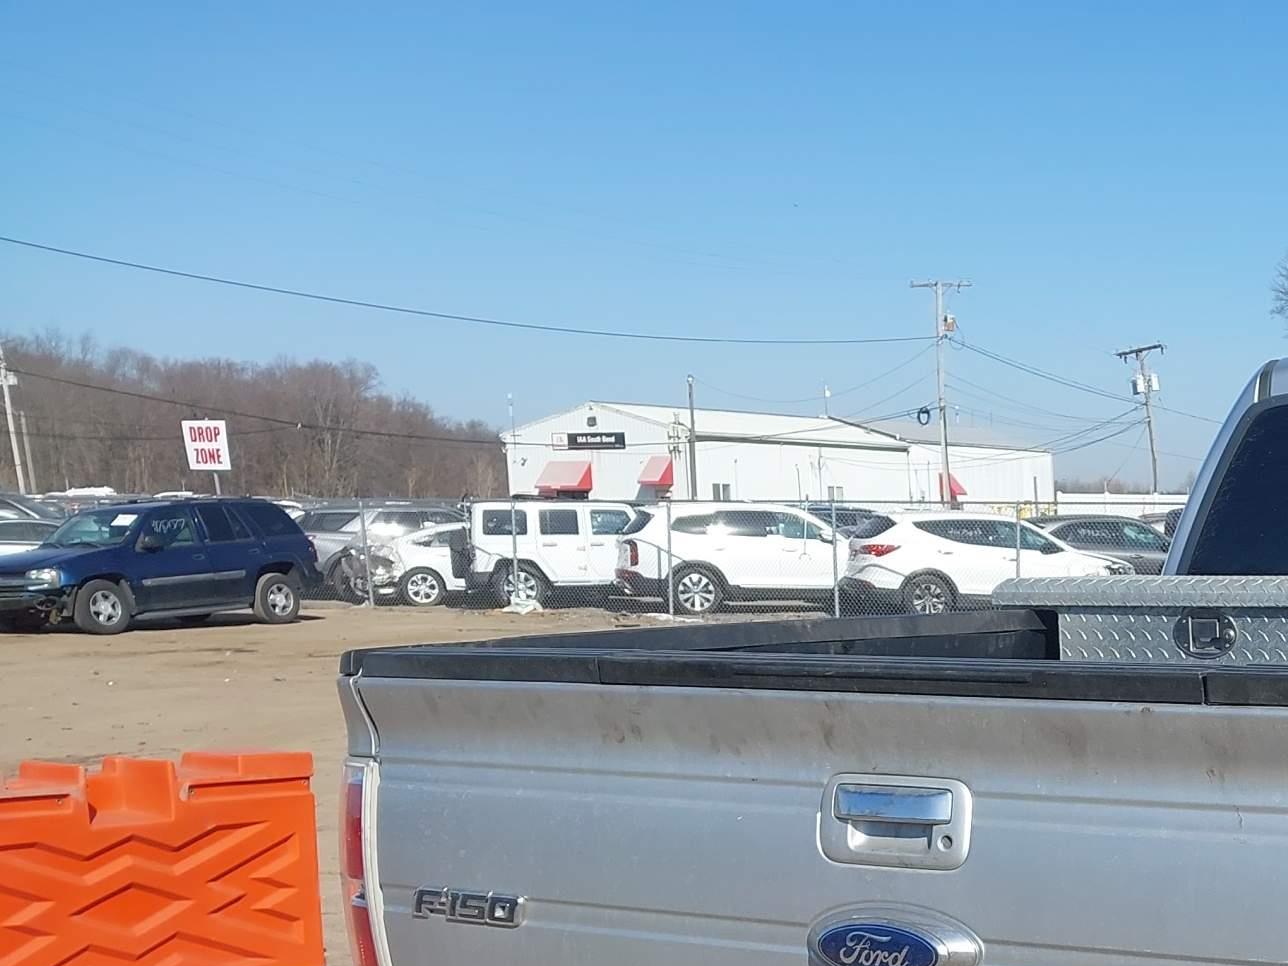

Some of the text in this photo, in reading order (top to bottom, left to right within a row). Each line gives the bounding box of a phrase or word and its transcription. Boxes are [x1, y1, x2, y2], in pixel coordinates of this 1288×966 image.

[189, 426, 220, 443] DROP
[194, 448, 223, 464] ZONE
[413, 888, 520, 924] F-150
